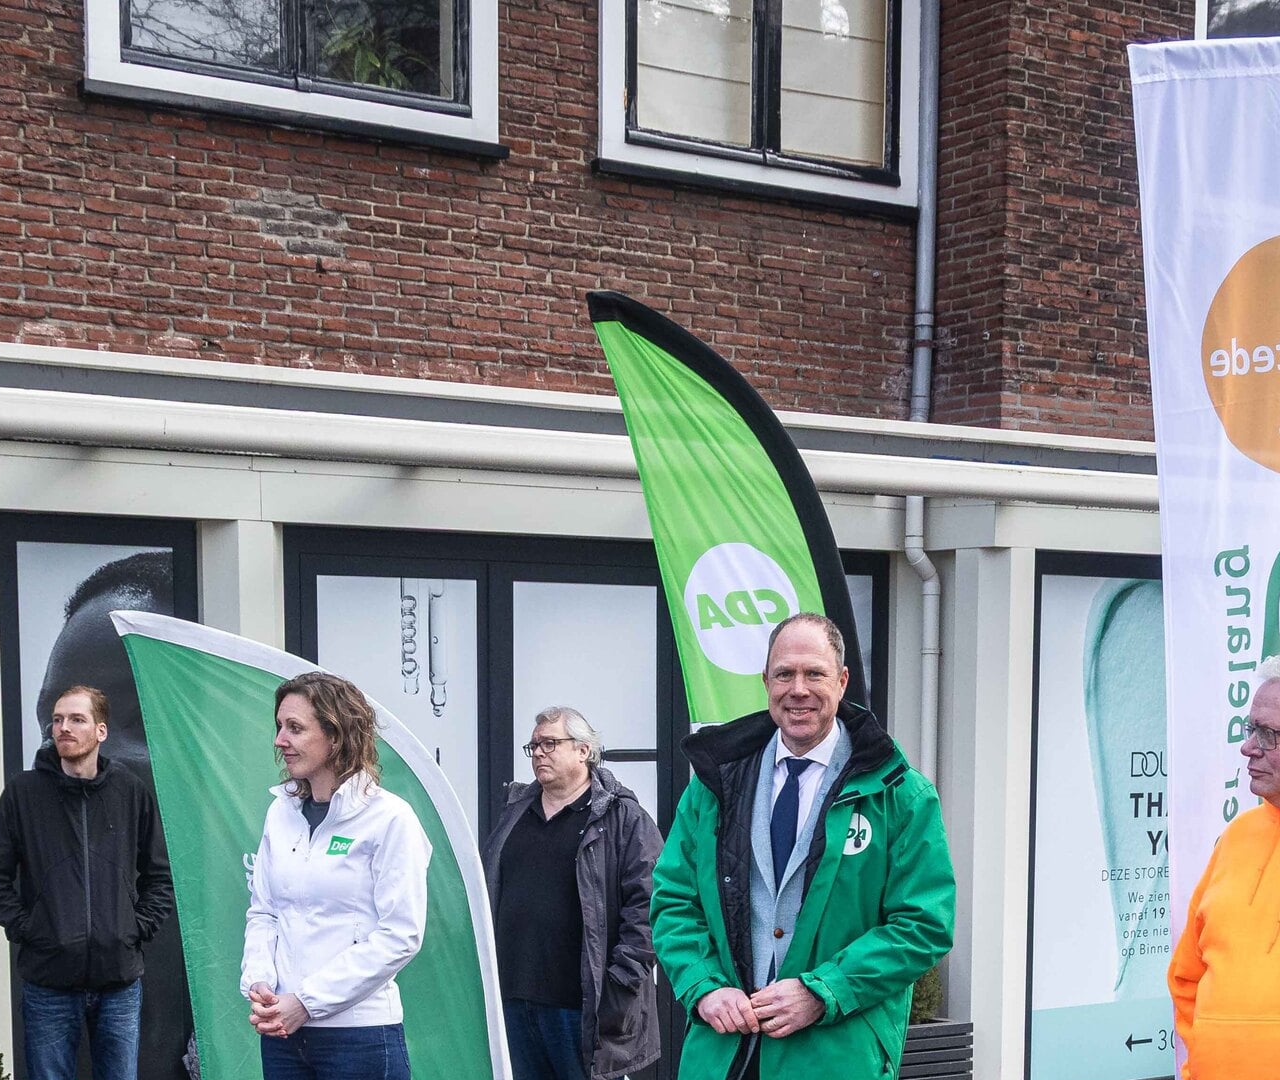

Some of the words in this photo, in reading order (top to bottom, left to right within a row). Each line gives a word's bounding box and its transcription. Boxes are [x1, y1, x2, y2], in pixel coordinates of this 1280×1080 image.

[1130, 751, 1168, 777] DOU
[1129, 791, 1168, 818] TH
[846, 828, 867, 840] DA
[1146, 830, 1169, 855] Y
[1101, 868, 1130, 882] DEZE
[1134, 866, 1169, 880] STORE
[1127, 891, 1145, 904] We
[1148, 890, 1170, 903] zien
[1118, 907, 1149, 922] vanaf
[1152, 907, 1166, 919] 19
[1122, 928, 1149, 940] onze
[1152, 924, 1171, 938] nie
[1121, 947, 1136, 959] op
[1139, 943, 1170, 956] Binne
